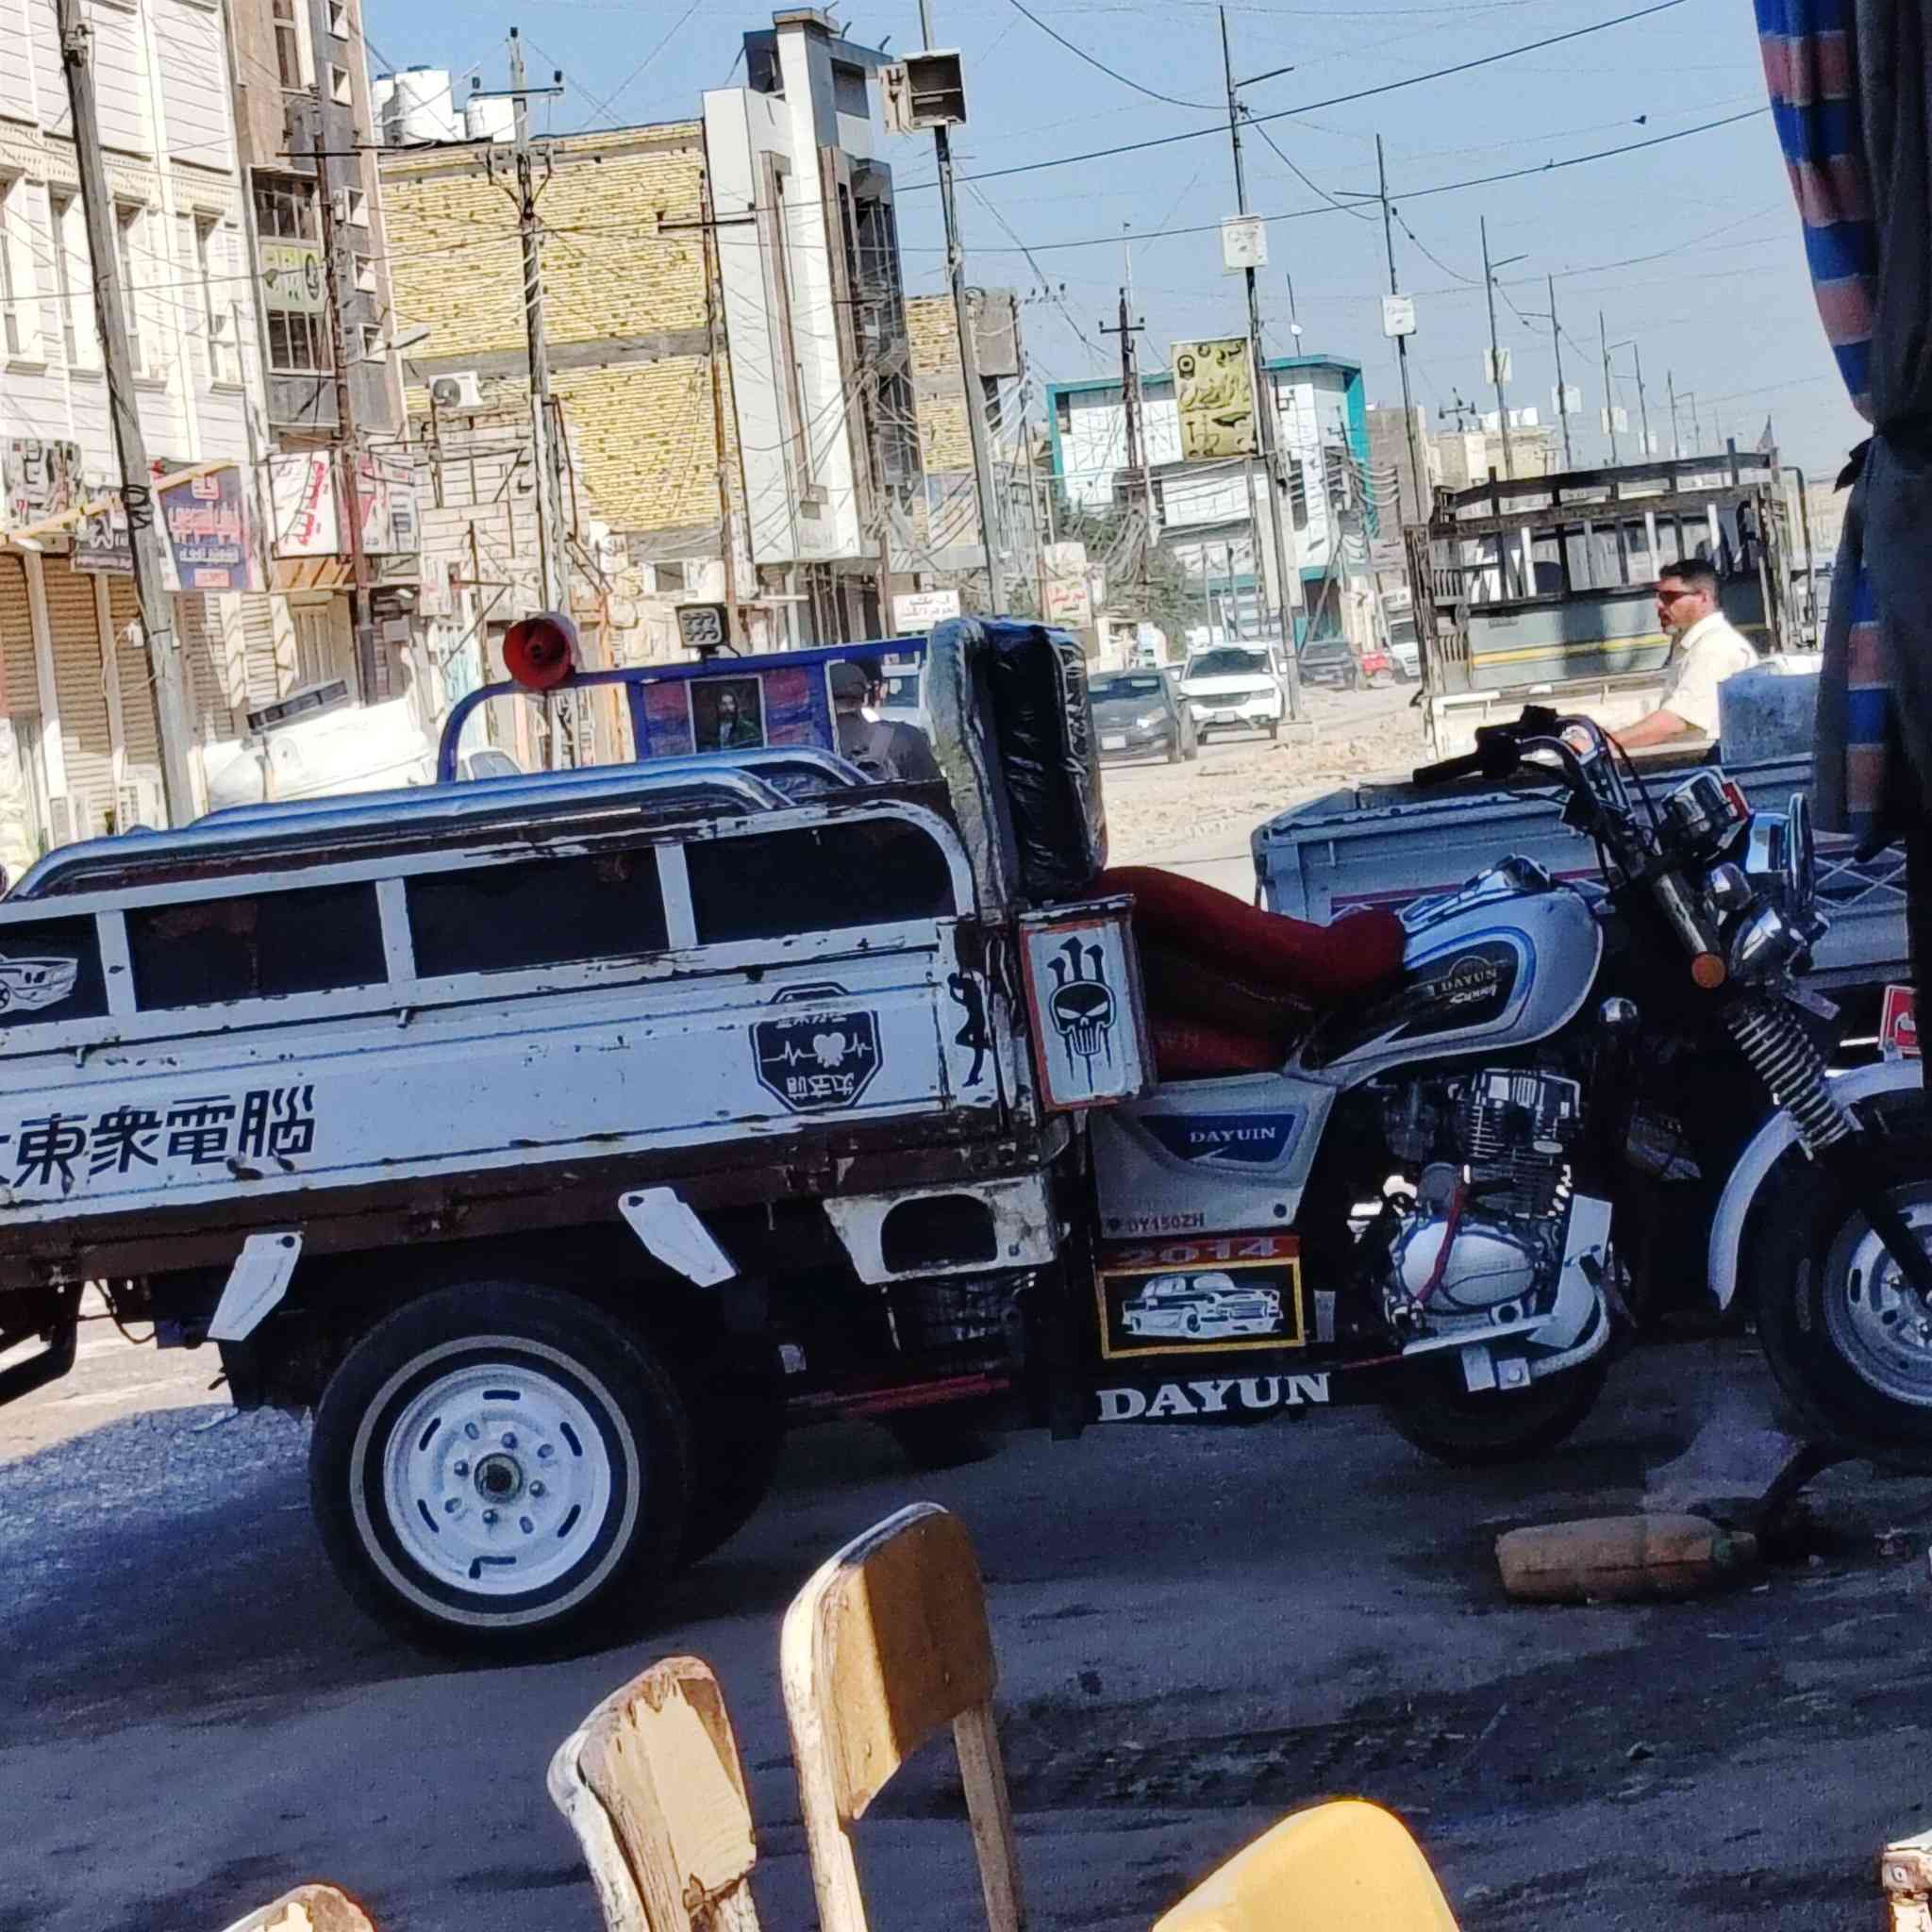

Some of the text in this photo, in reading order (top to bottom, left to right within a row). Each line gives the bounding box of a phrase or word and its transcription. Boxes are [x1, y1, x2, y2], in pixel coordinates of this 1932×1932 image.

[0, 1085, 315, 1189] 東衆電腦
[1095, 1372, 1331, 1422] DAYUN
